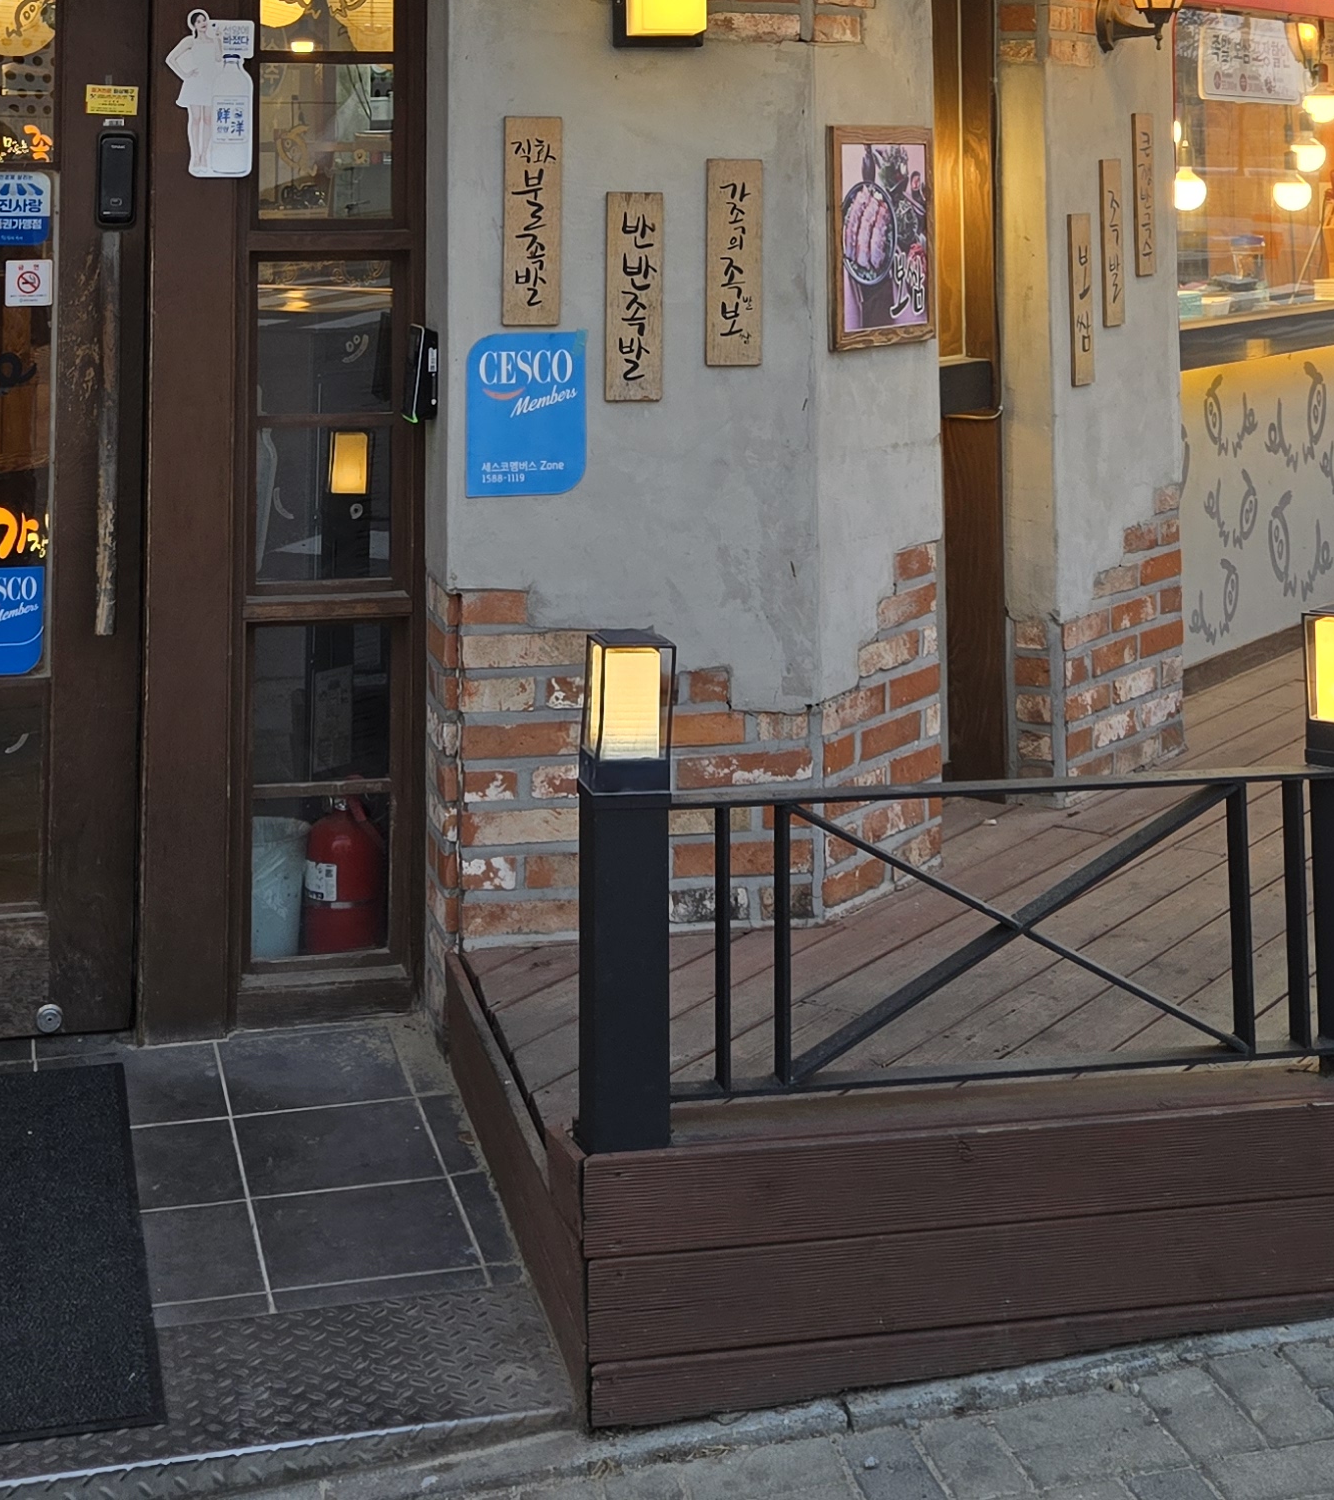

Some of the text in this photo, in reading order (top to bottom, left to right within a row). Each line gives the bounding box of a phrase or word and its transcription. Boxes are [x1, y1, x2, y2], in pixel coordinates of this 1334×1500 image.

[1106, 189, 1123, 304] 족발
[889, 252, 926, 319] 보쌈
[1076, 244, 1092, 353] 보쌈
[478, 348, 573, 385] CESCO
[509, 384, 579, 419] Members
[481, 460, 565, 473] 세스코멤버스 Zone
[481, 473, 526, 484] 1588-1119
